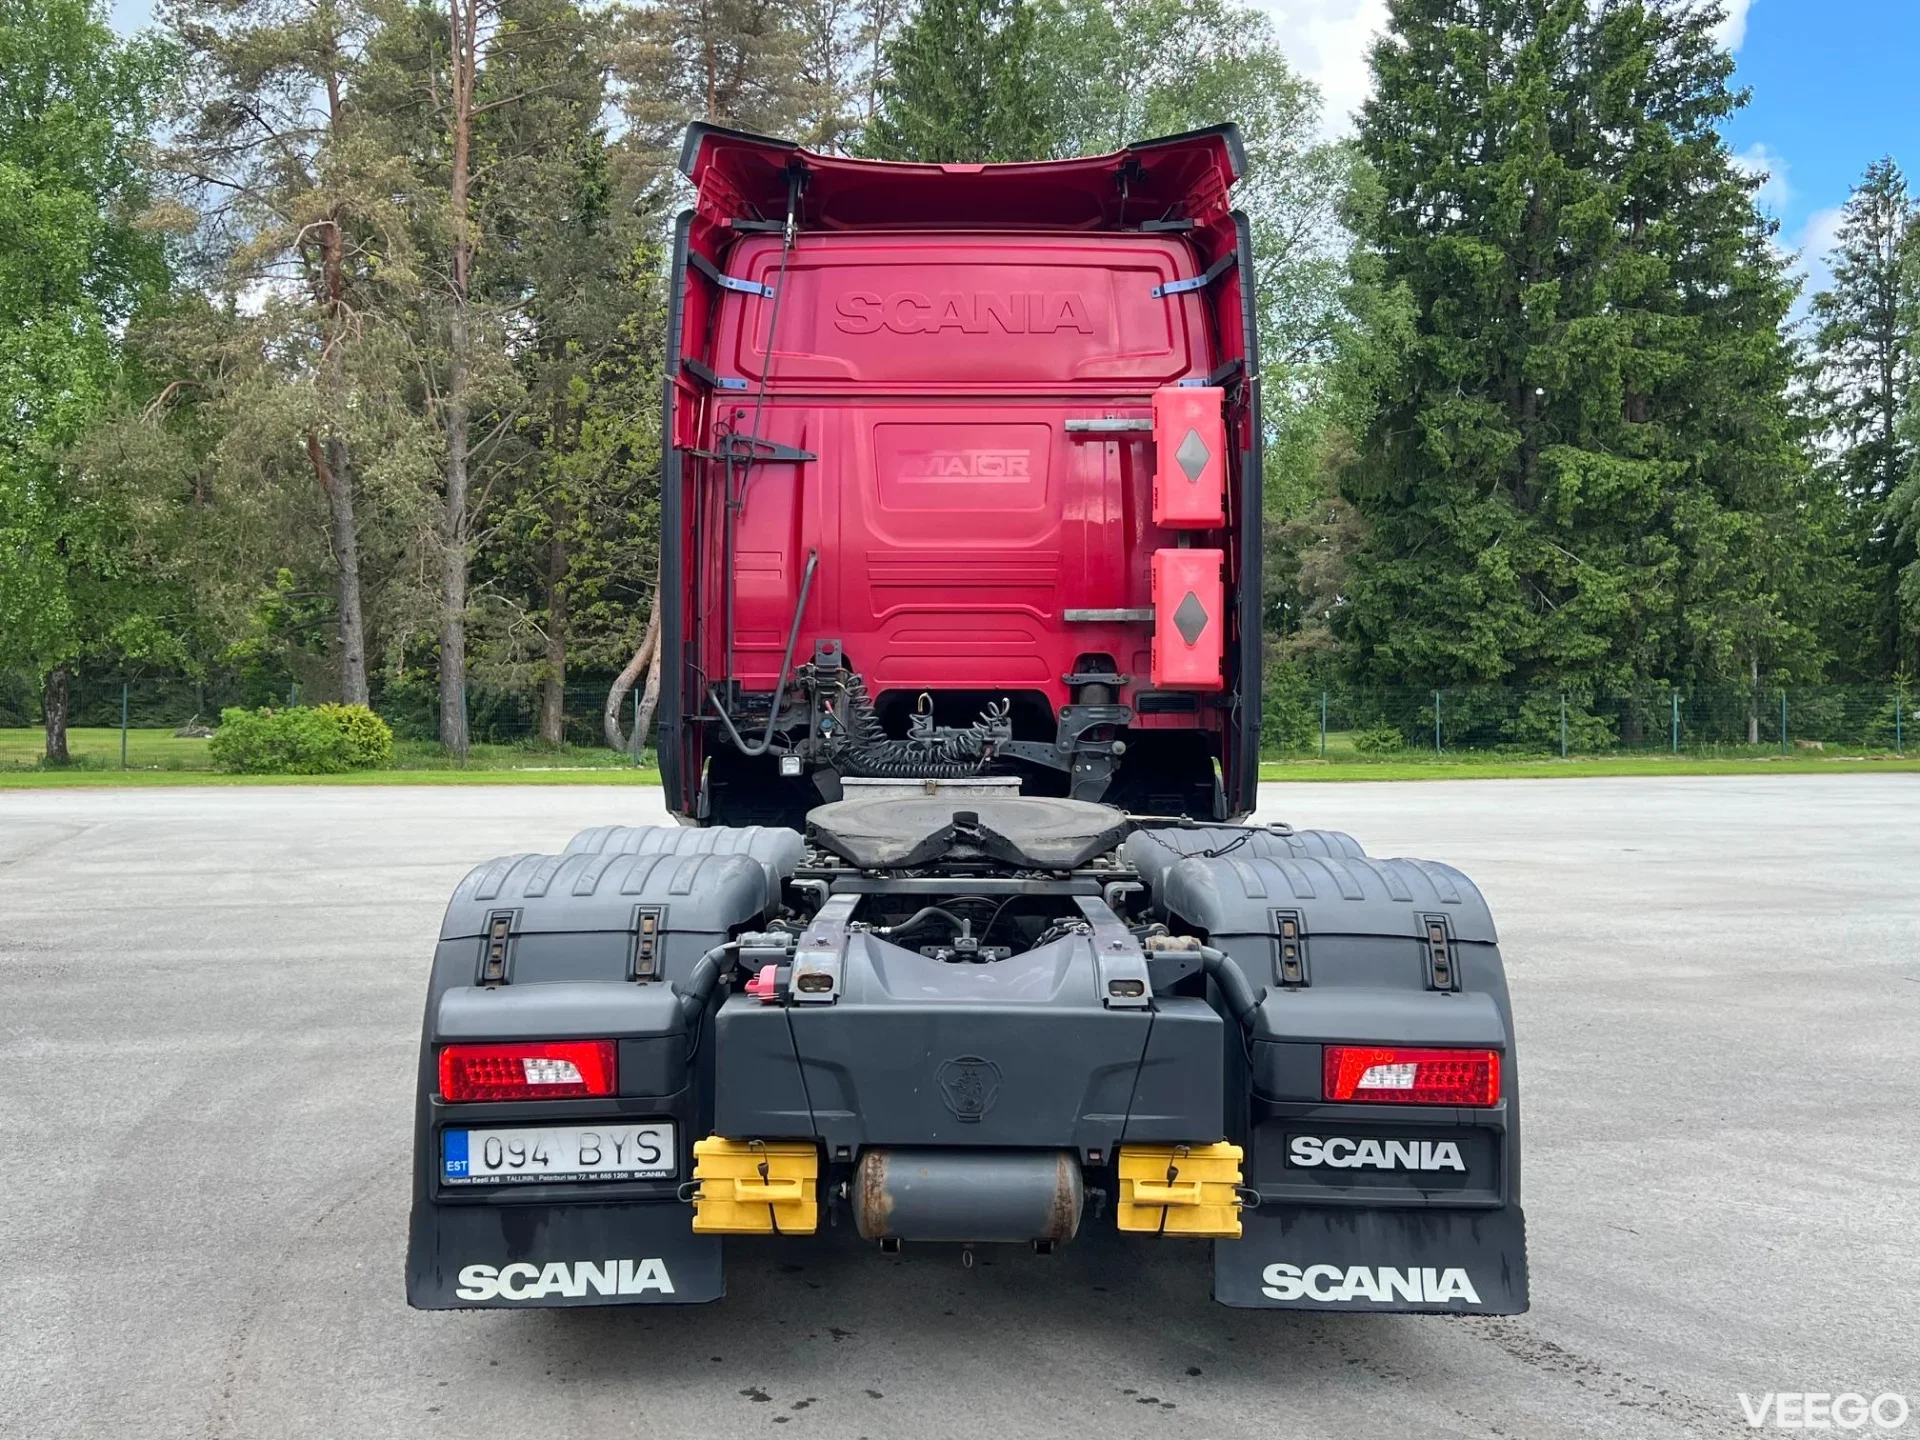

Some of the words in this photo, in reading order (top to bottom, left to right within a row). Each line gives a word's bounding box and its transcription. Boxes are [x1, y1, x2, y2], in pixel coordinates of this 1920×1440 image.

[834, 291, 1094, 335] SCANIA
[446, 1160, 468, 1171] EST
[484, 1133, 549, 1170] 094
[579, 1130, 661, 1165] BYS
[1290, 1136, 1466, 1171] SCANIA
[456, 1258, 675, 1300] SCANIA
[1261, 1263, 1482, 1304] SCANIA
